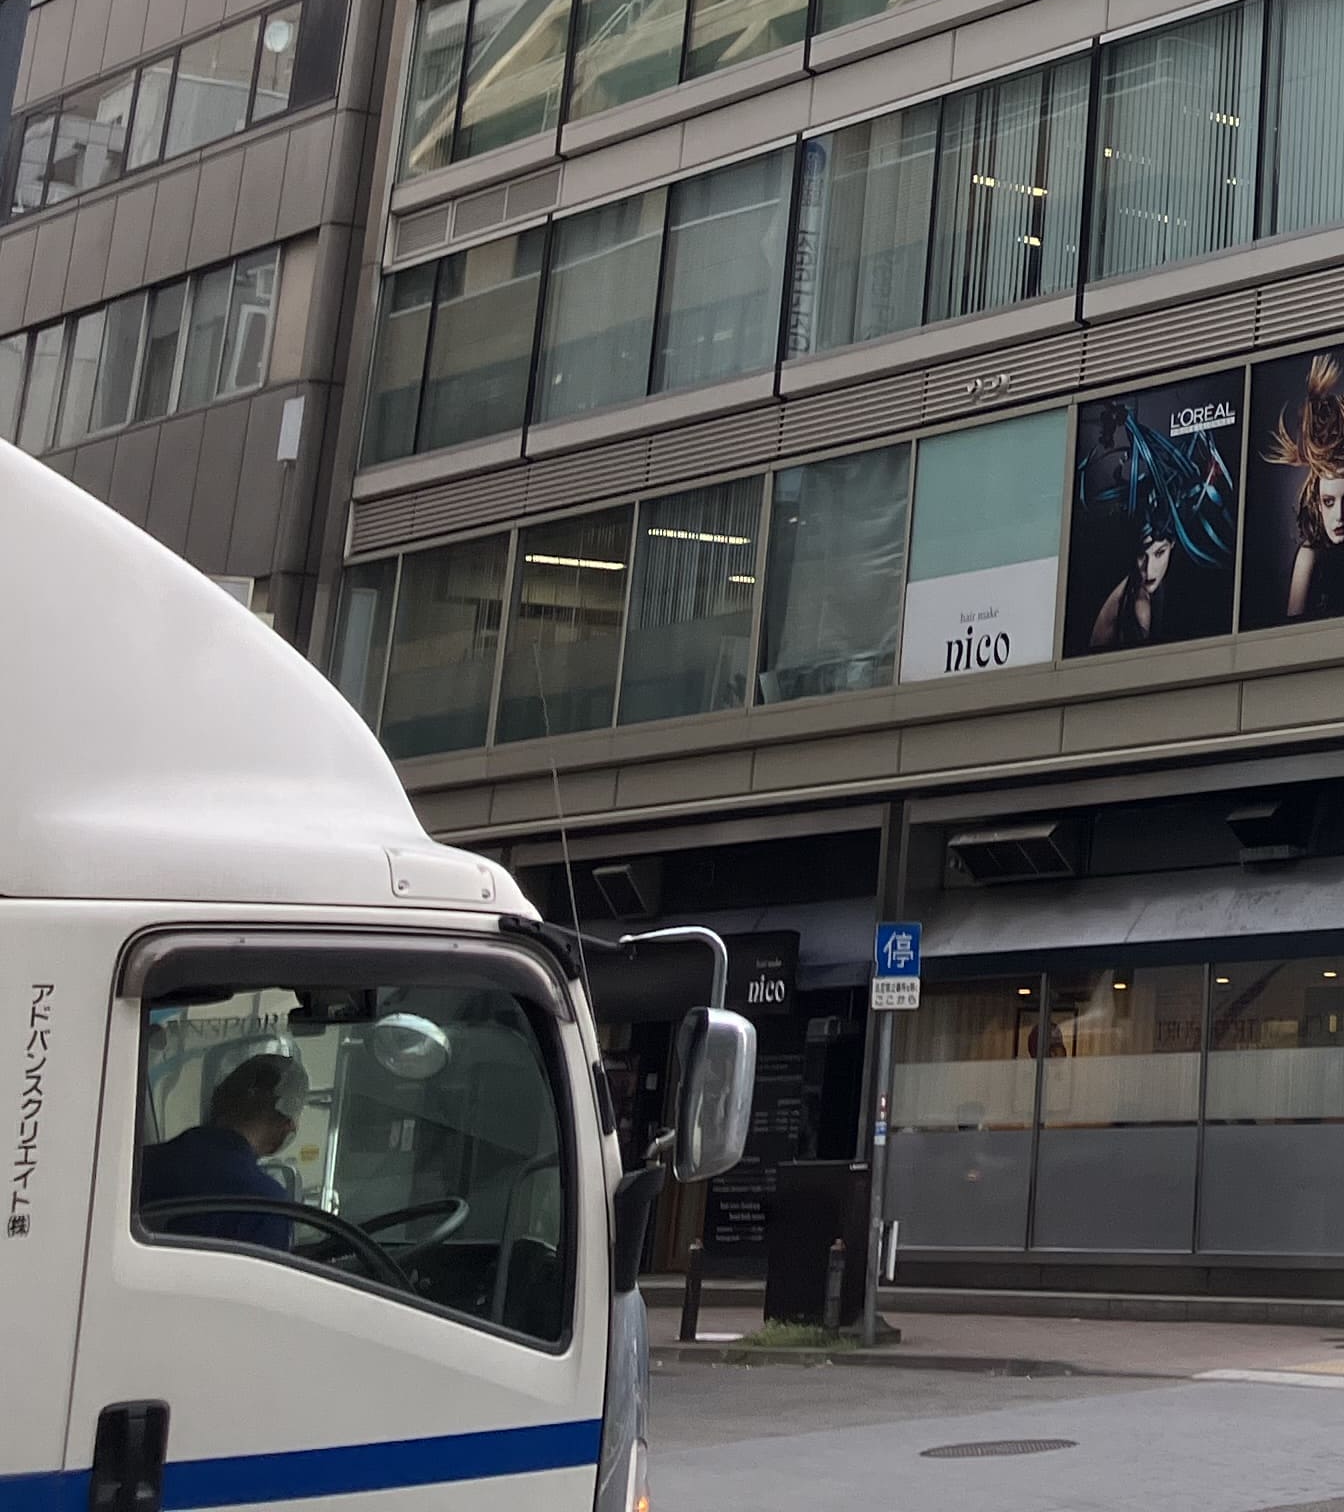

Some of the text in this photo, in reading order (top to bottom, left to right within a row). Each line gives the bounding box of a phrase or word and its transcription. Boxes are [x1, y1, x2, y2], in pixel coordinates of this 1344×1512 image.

[944, 625, 1010, 673] nico
[883, 931, 914, 968] 停
[748, 974, 785, 1003] nico
